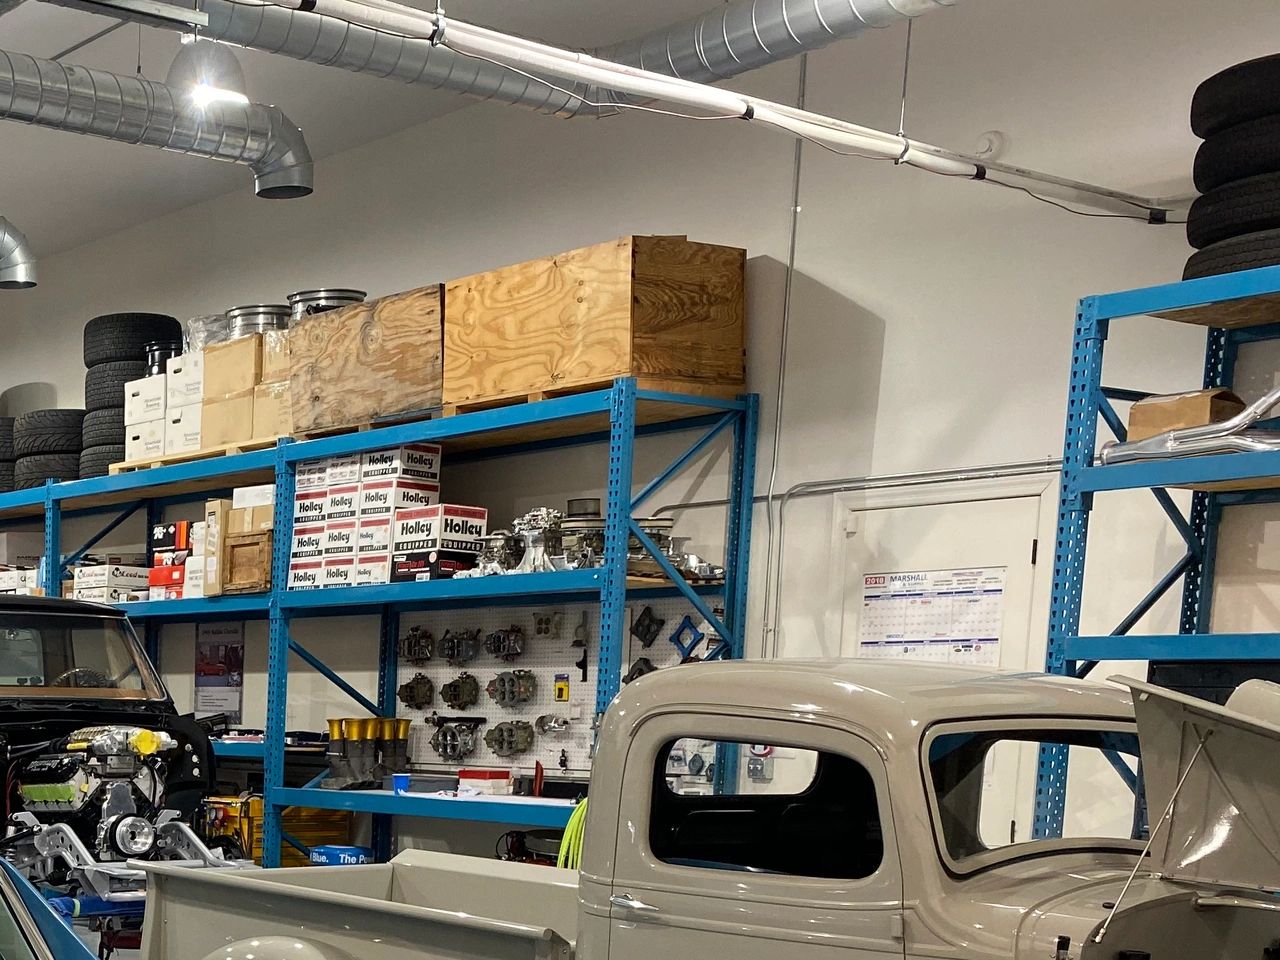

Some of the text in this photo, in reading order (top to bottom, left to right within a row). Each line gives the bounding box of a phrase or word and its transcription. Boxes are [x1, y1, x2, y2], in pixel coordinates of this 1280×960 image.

[368, 453, 395, 467] Holley
[406, 452, 434, 469] Holley
[331, 496, 353, 508] Holley
[364, 491, 388, 504] Holley
[402, 491, 431, 506] Holley
[299, 501, 324, 515] Holley
[401, 520, 432, 537] Holley
[444, 518, 483, 537] Holley
[297, 536, 320, 549] Holley
[328, 531, 351, 544] Holley
[360, 532, 374, 540] Holley
[400, 540, 432, 550] EQUIPPED
[443, 541, 481, 551] EQUIPPED
[293, 571, 317, 584] Holley
[326, 568, 349, 581] Holley
[890, 573, 928, 582] MARSHALL
[339, 853, 357, 864] The
